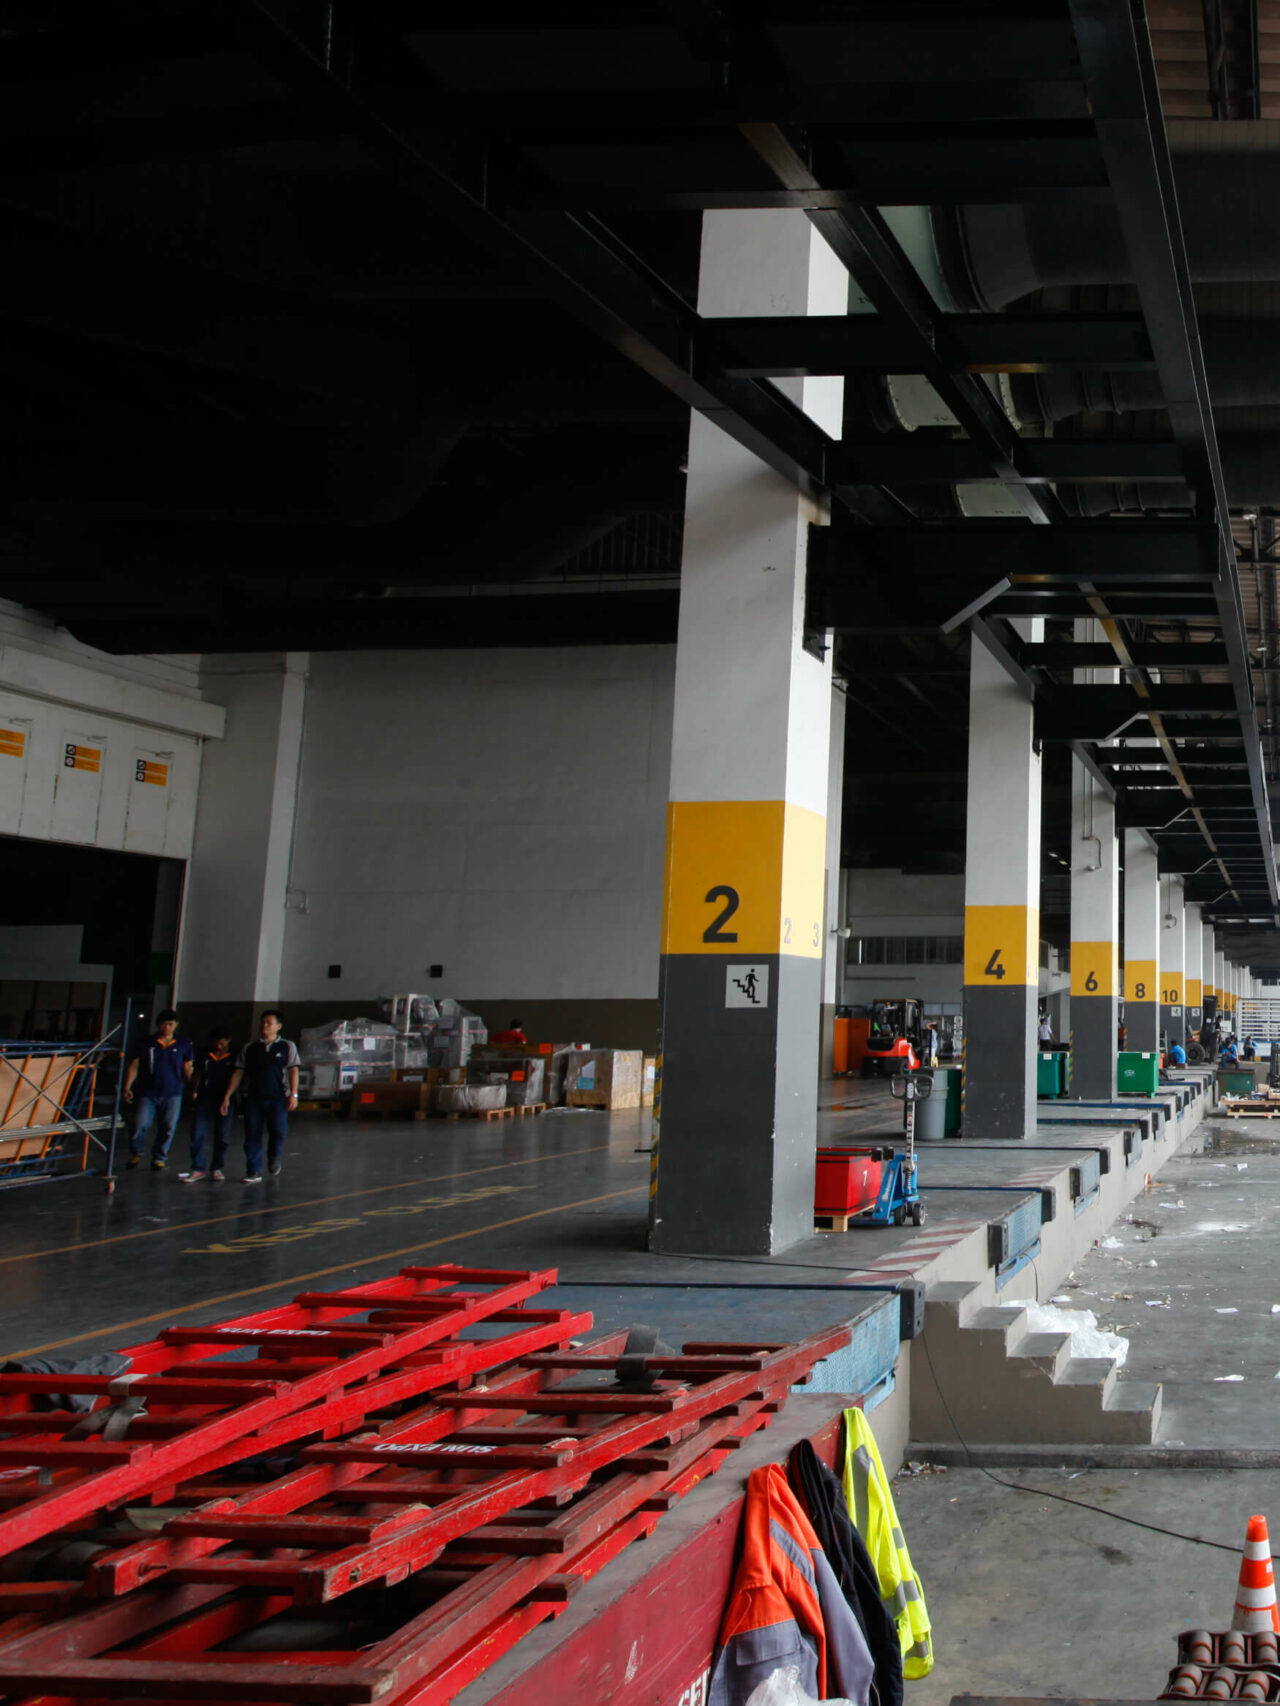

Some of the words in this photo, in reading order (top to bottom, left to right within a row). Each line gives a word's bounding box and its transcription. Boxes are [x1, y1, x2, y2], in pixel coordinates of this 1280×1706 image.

[703, 885, 739, 943] 2
[784, 917, 792, 944] 2
[812, 922, 820, 947] 3
[984, 949, 1006, 979] 4
[1085, 971, 1098, 992] 6
[1135, 983, 1146, 999] 8
[1162, 990, 1178, 1003] 10
[179, 1217, 368, 1253] KEEP
[361, 1185, 537, 1216] CLEAR
[372, 1442, 444, 1452] EXPO
[440, 1444, 499, 1454] SUN
